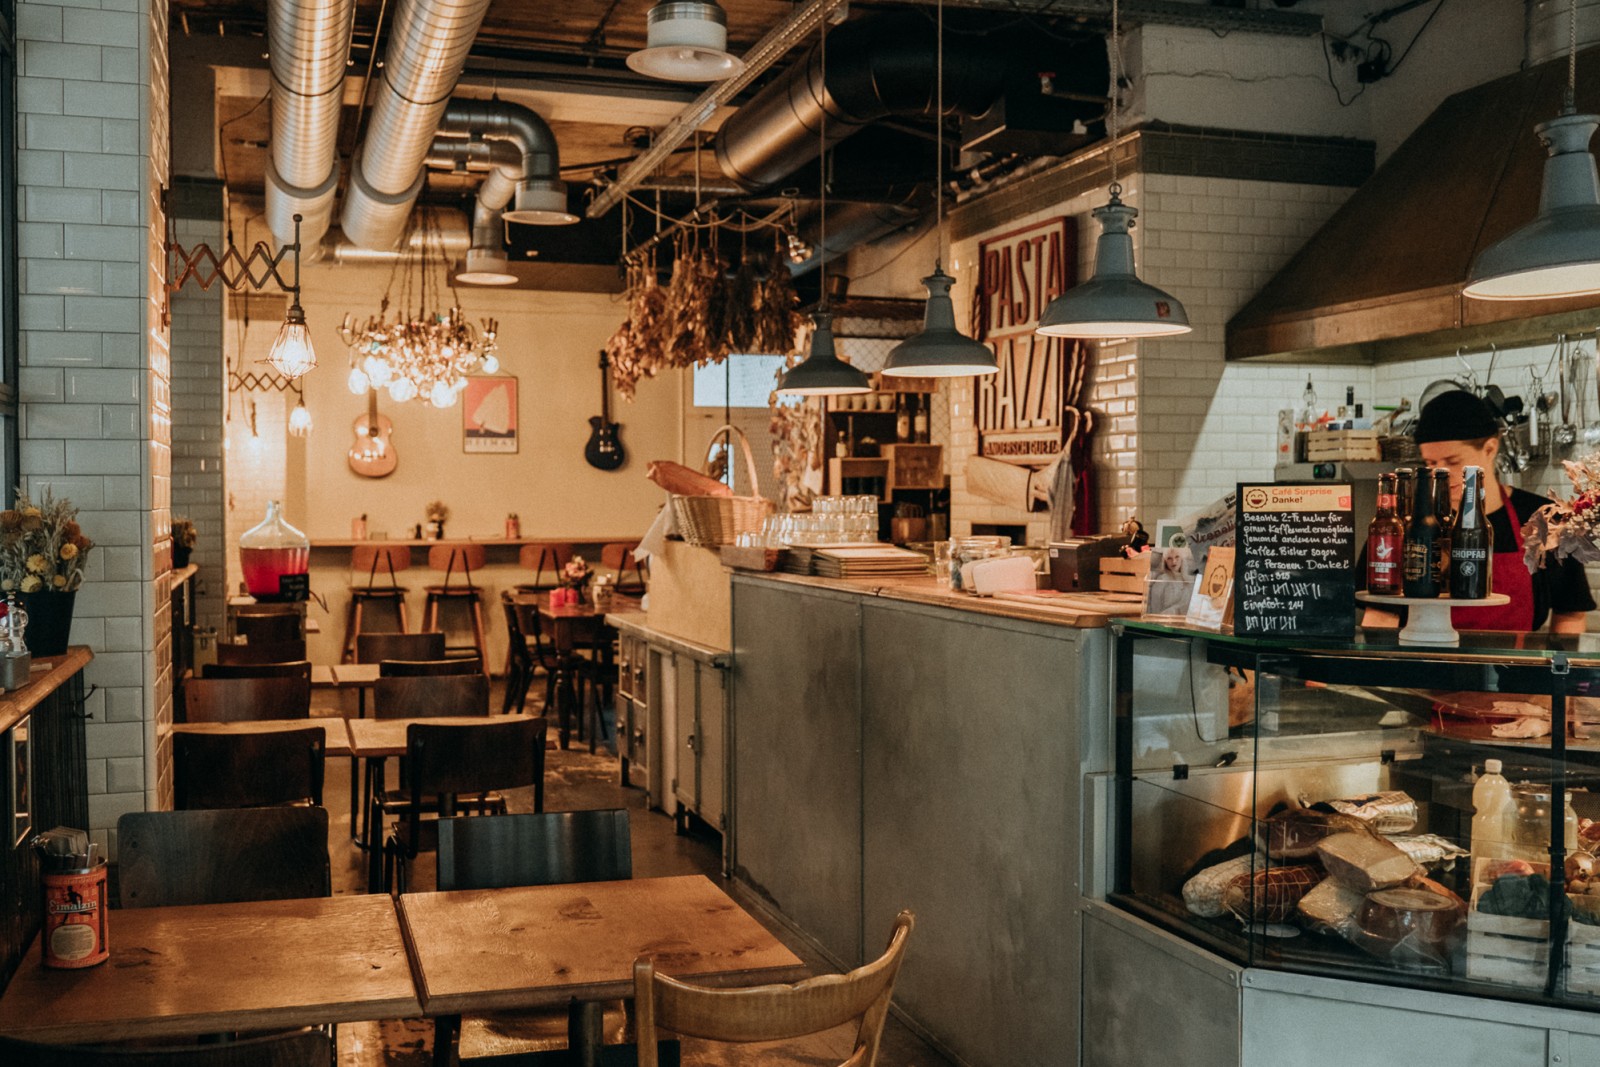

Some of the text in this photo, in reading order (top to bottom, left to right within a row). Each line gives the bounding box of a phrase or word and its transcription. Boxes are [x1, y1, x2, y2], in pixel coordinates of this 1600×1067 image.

[985, 231, 1063, 332] PASTA
[981, 335, 1058, 430] RAZZI
[1272, 487, 1333, 498] Café Surprise
[1272, 496, 1303, 504] Danke!
[1302, 513, 1326, 523] mehr
[1328, 512, 1343, 524] für
[1243, 522, 1266, 534] einen
[1281, 535, 1321, 544] anderem
[1322, 536, 1348, 544] einen
[1279, 546, 1308, 556] Bisher
[1311, 547, 1337, 561] sagen
[1452, 550, 1486, 558] CHOPFAB
[49, 899, 97, 914] Eimalzin
